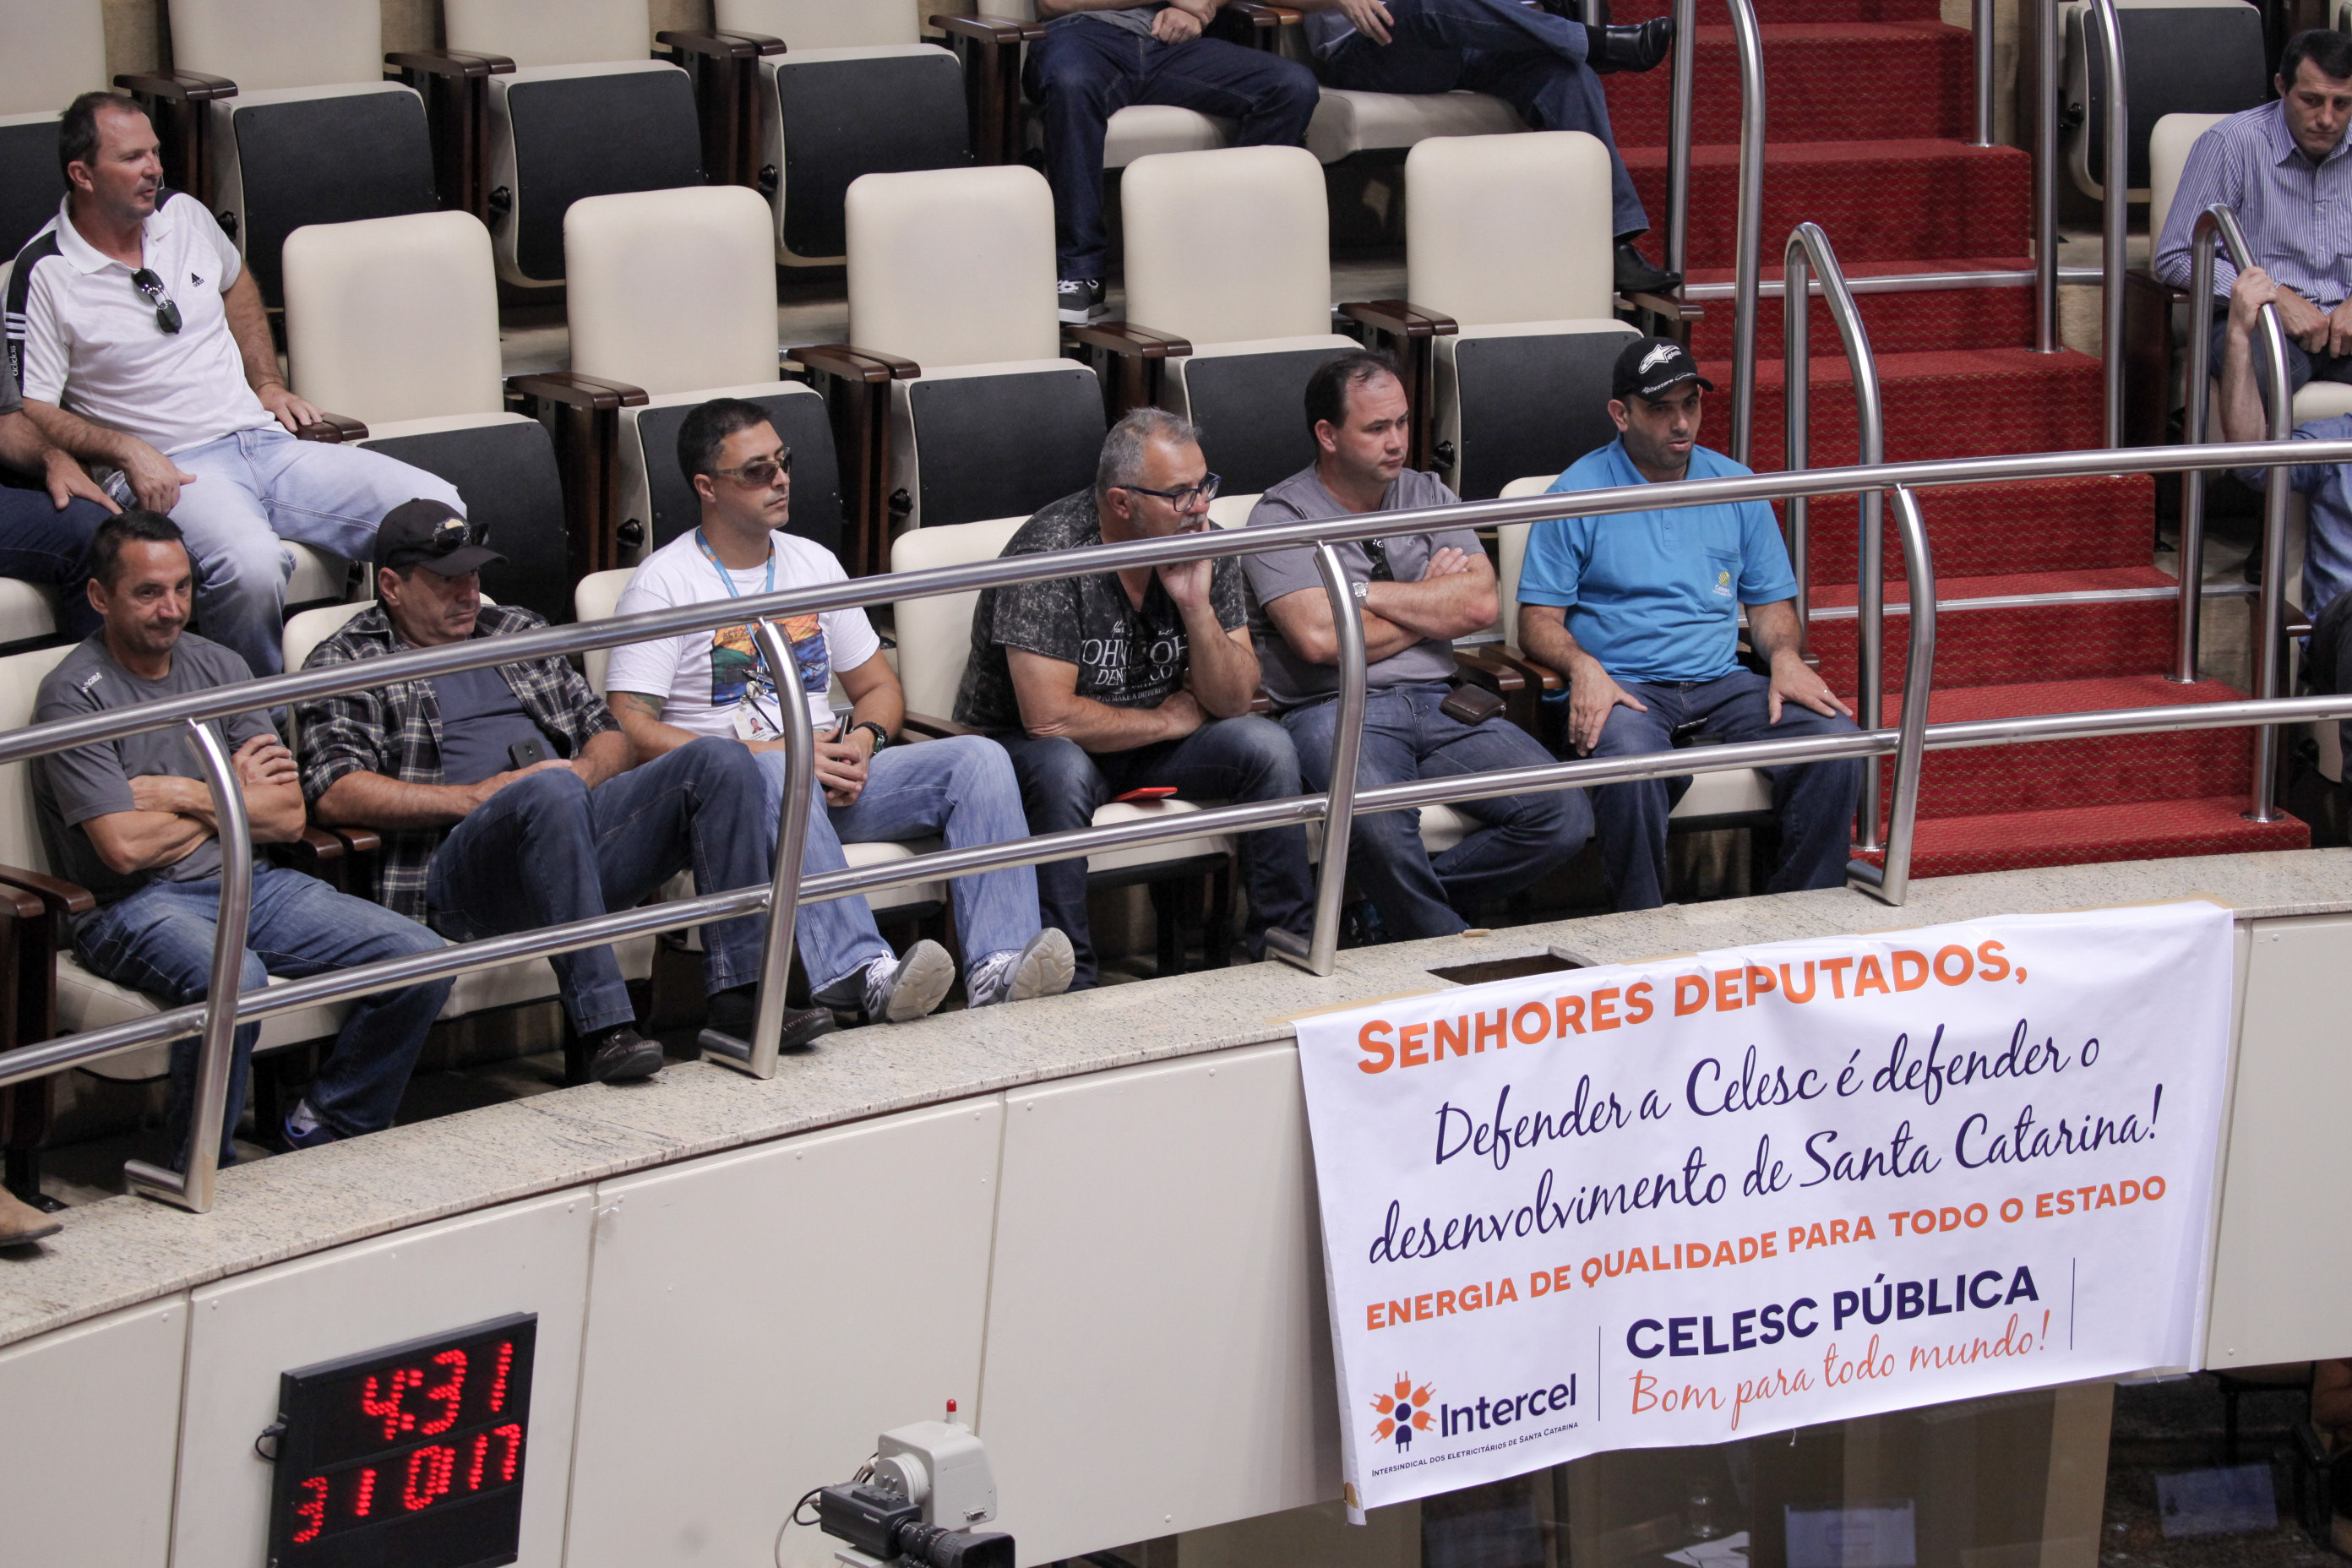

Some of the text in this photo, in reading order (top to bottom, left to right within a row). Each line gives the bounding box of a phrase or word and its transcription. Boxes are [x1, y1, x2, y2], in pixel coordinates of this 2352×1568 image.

[9, 345, 19, 377] adidas
[1358, 939, 2028, 1075] SENHORES DEPUTADOS,
[1435, 1018, 2100, 1171] Defender a Celesc é defender o
[1369, 1083, 2163, 1264] desenvolvimento de Santa Catarina!
[1366, 1174, 2168, 1331] ENERGIA DE QUALIDADE PARA TODO O ESTADO
[1626, 1266, 2040, 1359] CELESC PÚBLICA
[1440, 1373, 1577, 1439] Intercel
[1629, 1309, 2051, 1432] Bom para todo mundo!
[1371, 1421, 1579, 1478] INTERSINDICAL DOS ELETRICITÁRIOS DE SANTA CATARINA
